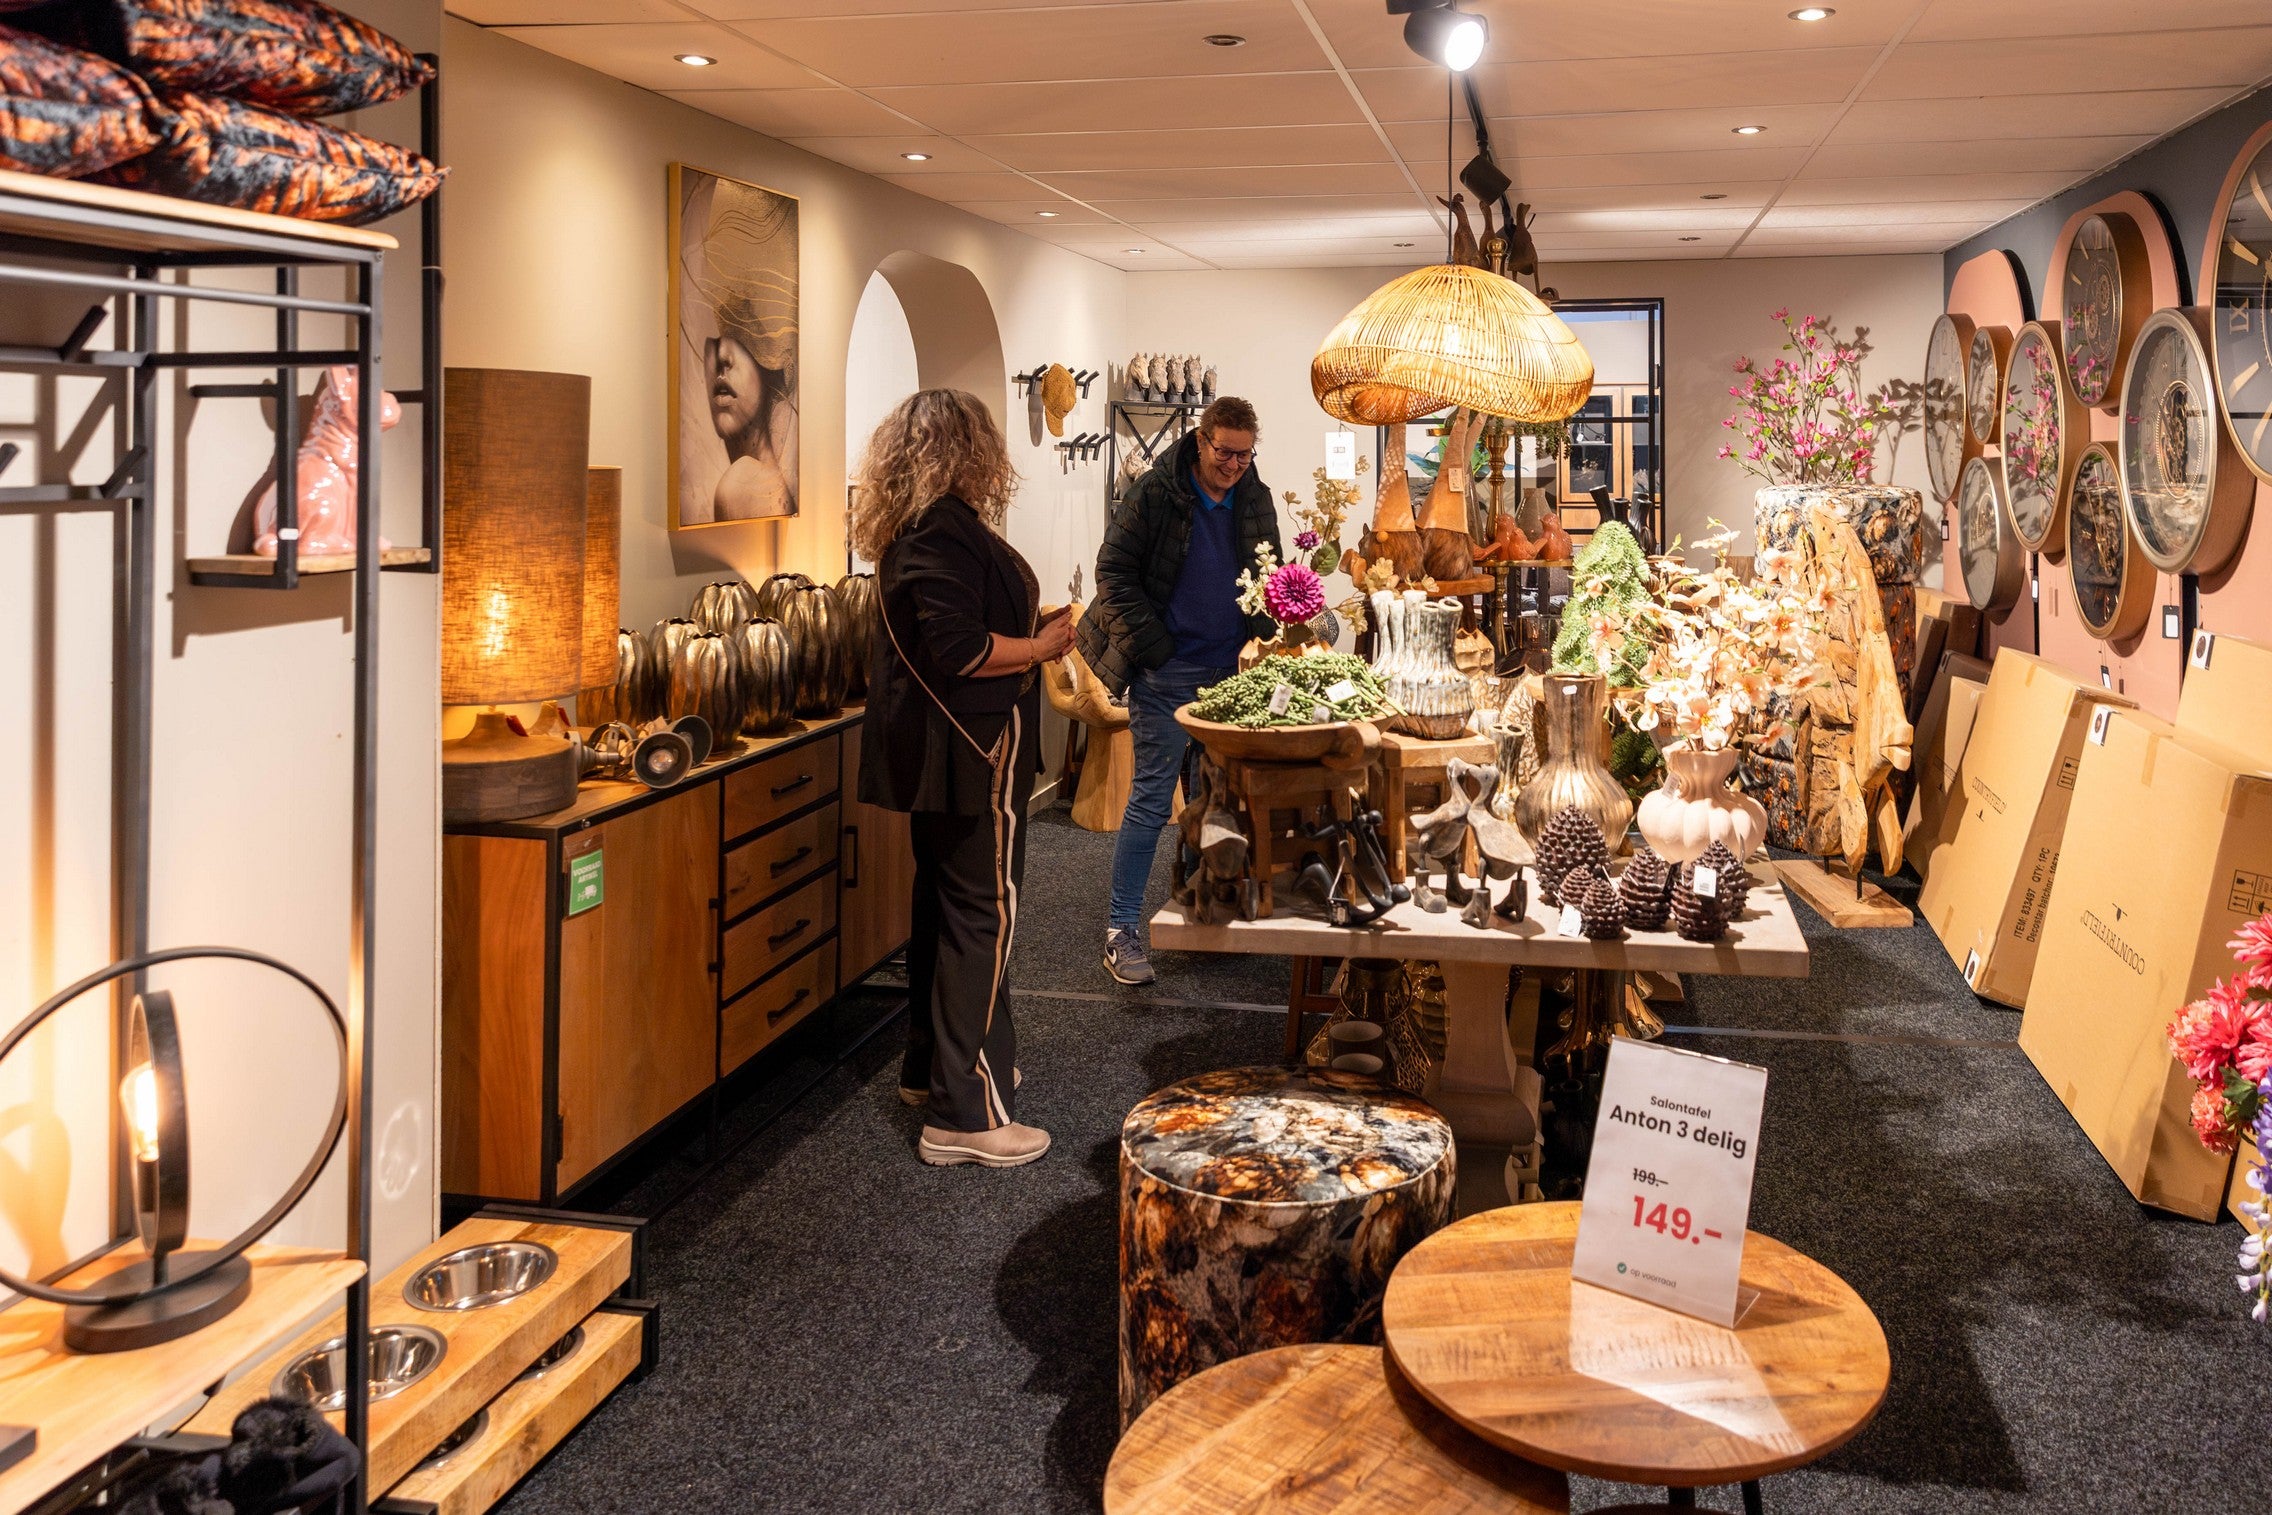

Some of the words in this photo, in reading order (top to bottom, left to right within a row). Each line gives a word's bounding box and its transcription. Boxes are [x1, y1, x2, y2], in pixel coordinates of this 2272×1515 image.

[2013, 916, 2026, 939] ITEM:
[2021, 888, 2036, 916] 833497
[2031, 864, 2045, 883] QTY:
[2038, 847, 2051, 863] 1PC
[2026, 909, 2046, 943] Decostar
[1650, 1096, 1712, 1120] Salontafel
[1609, 1104, 1671, 1135] Anton
[1677, 1120, 1688, 1139] 3
[1693, 1124, 1747, 1159] delig
[1630, 1268, 1641, 1278] op
[1641, 1271, 1677, 1289] voorraad
